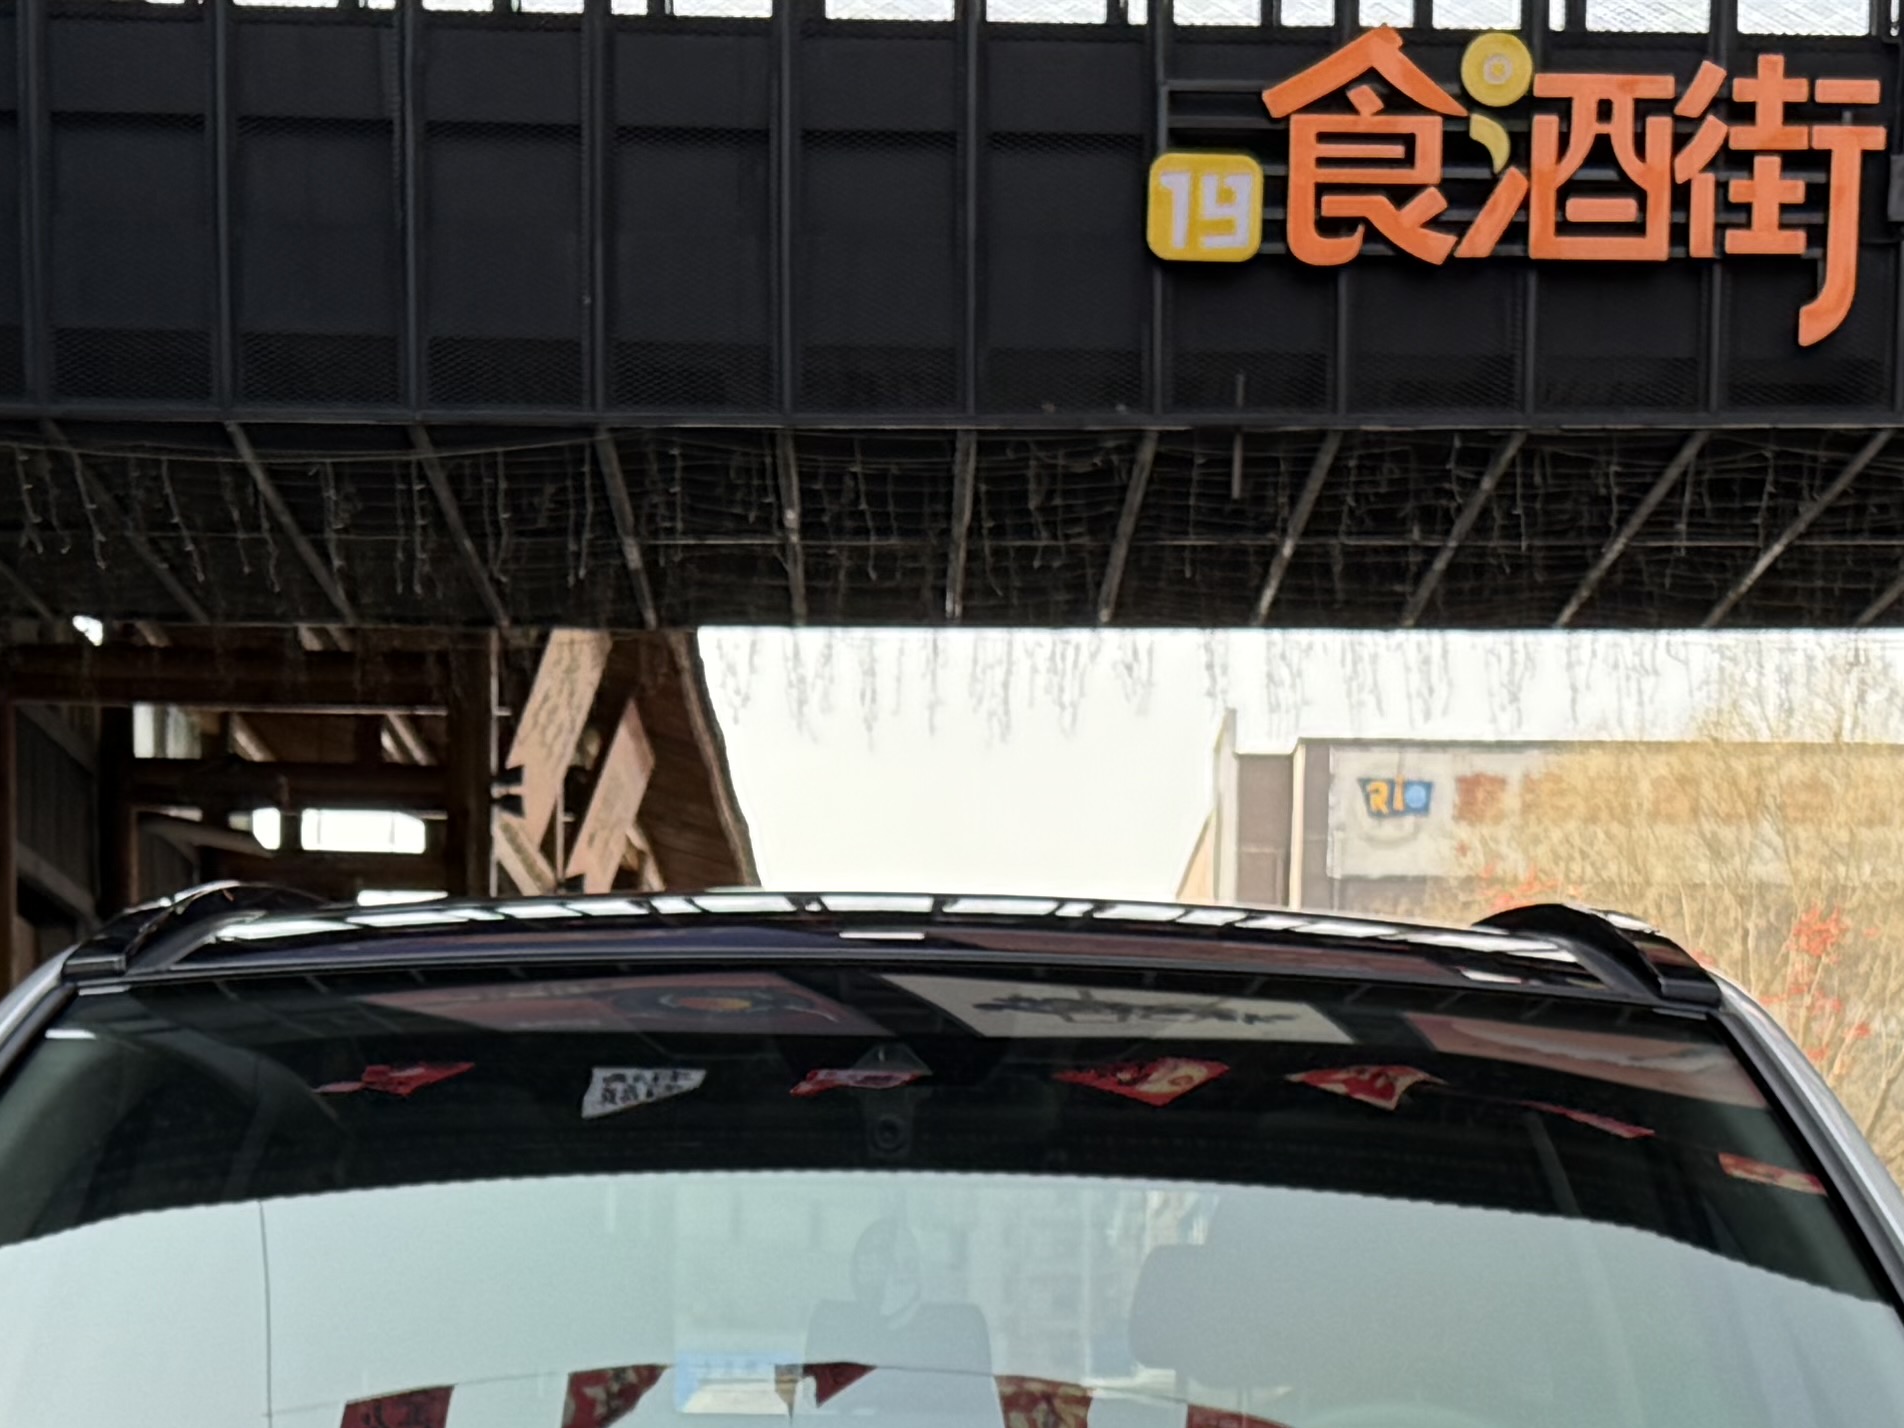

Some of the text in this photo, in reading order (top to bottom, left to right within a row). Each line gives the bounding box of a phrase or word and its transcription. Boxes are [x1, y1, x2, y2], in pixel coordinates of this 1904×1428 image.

[1159, 24, 1887, 347] 19 食酒街
